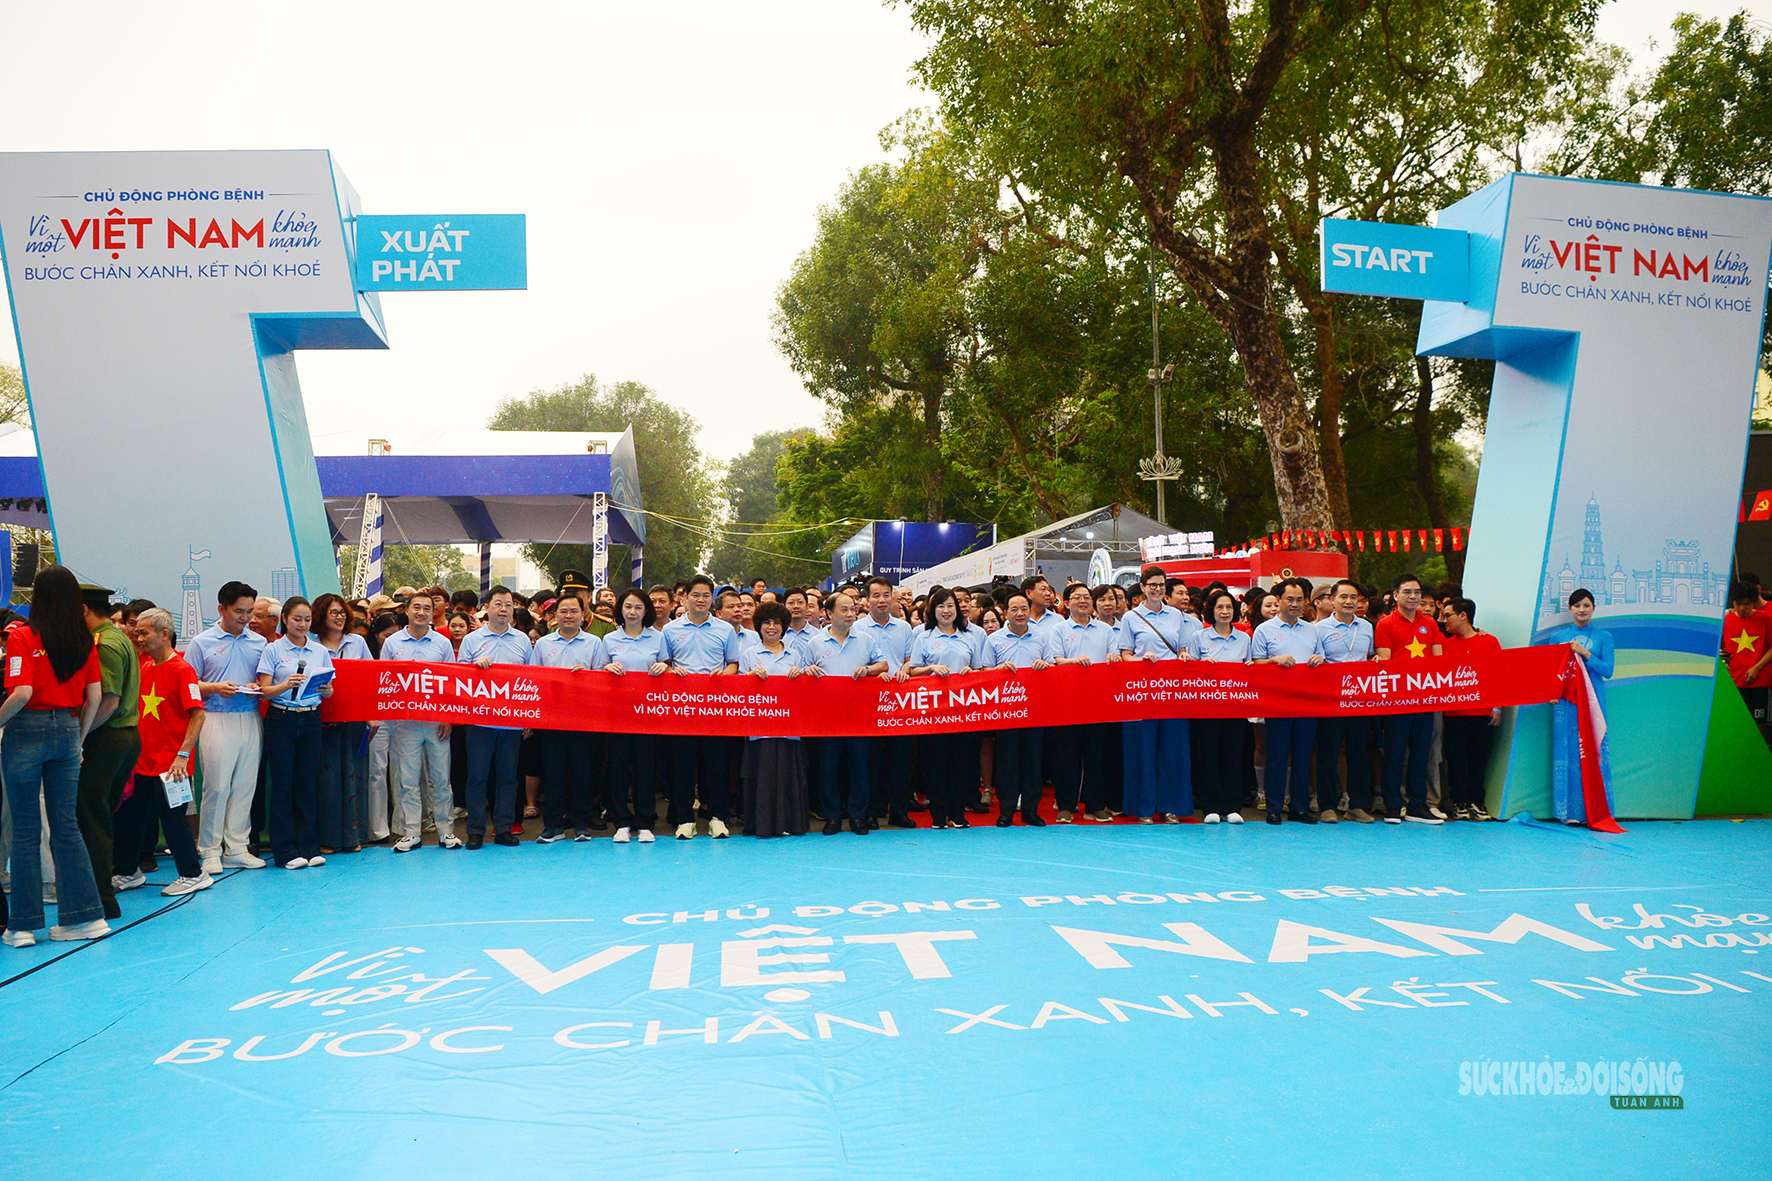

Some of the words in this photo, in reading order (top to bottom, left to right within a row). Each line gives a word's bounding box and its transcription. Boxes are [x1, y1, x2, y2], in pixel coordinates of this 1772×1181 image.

[84, 188, 115, 202] CHỦ
[119, 189, 163, 204] ĐỘNG
[167, 188, 220, 201] PHÒNG
[224, 188, 264, 203] BỆNH
[30, 215, 50, 236] Vì
[60, 207, 152, 260] VIỆT
[167, 217, 264, 249] NAM
[380, 222, 470, 252] XUẤT
[1568, 216, 1592, 228] CHỦ
[1596, 219, 1630, 232] ĐỘNG
[1633, 222, 1674, 236] PHÒNG
[1677, 226, 1708, 240] BỆNH
[25, 232, 66, 258] một
[269, 225, 322, 253] mạnh
[1524, 234, 1540, 254] Vì
[25, 263, 74, 280] BƯỚC
[80, 263, 131, 280] CHÂN
[137, 264, 192, 280] XANH,
[198, 260, 229, 278] KẾT
[235, 260, 267, 278] NỐI
[372, 252, 461, 282] PHÁT
[1332, 243, 1434, 274] START
[1522, 252, 1554, 274] một
[1549, 234, 1622, 282] VIỆT
[1634, 247, 1708, 282] NAM
[1712, 266, 1752, 289] mạnh
[1522, 280, 1561, 296] BƯỚC
[1566, 285, 1606, 300] CHÂN
[1610, 289, 1654, 306] XANH,
[1658, 290, 1682, 306] KẾT
[1686, 292, 1711, 309] NỐI
[1189, 531, 1214, 542] NAM
[378, 680, 400, 698] một
[396, 668, 448, 700] VIỆT
[455, 677, 510, 700] NAM
[1114, 692, 1124, 702] VÌ
[1126, 691, 1149, 703] MỘT
[1150, 690, 1172, 702] VIỆT
[1174, 691, 1198, 700] NAM
[1200, 689, 1228, 700] KHỎE
[1230, 692, 1259, 702] MẠNH
[1126, 678, 1148, 690] CHỦ
[1150, 678, 1180, 690] ĐỘNG
[1182, 677, 1218, 688] PHÒNG
[1220, 679, 1248, 690] BỆNH
[1356, 670, 1400, 698] VIỆT
[1406, 670, 1453, 691] NAM
[378, 699, 406, 710] BƯỚC
[408, 701, 437, 712] CHÂN
[439, 703, 470, 714] XANH,
[472, 704, 490, 716] KẾT
[492, 705, 511, 717] NỐI
[646, 690, 669, 702] CHỦ
[672, 692, 704, 704] ĐỘNG
[707, 693, 746, 704] PHÒNG
[748, 693, 778, 705] BỆNH
[894, 686, 942, 715] VIỆT
[949, 686, 1000, 708] NAM
[1422, 694, 1438, 705] KẾT
[1440, 693, 1456, 704] NỐI
[634, 704, 644, 714] VÌ
[646, 705, 670, 717] MỘT
[673, 705, 696, 718] VIỆT
[698, 706, 723, 716] NAM
[726, 704, 756, 717] KHỎE
[758, 708, 790, 719] MẠNH
[906, 714, 932, 726] CHÂN
[934, 714, 964, 725] XANH,
[965, 710, 982, 722] KẾT
[984, 709, 1001, 720] NỐI
[622, 904, 771, 925] CHỦ
[791, 898, 1002, 918] ĐỘNG
[1019, 890, 1267, 908] PHÒNG
[1276, 886, 1467, 901] BỆNH
[290, 946, 425, 984] Vì
[482, 924, 978, 1002] VIỆT
[1048, 912, 1617, 970] NAM
[228, 968, 492, 1016] một
[153, 1022, 513, 1065] BƯỚC
[553, 1010, 900, 1048] CHÂN
[934, 992, 1309, 1034] XANH,
[1318, 977, 1512, 1012] KẾT
[1530, 968, 1752, 1000] NỐI
